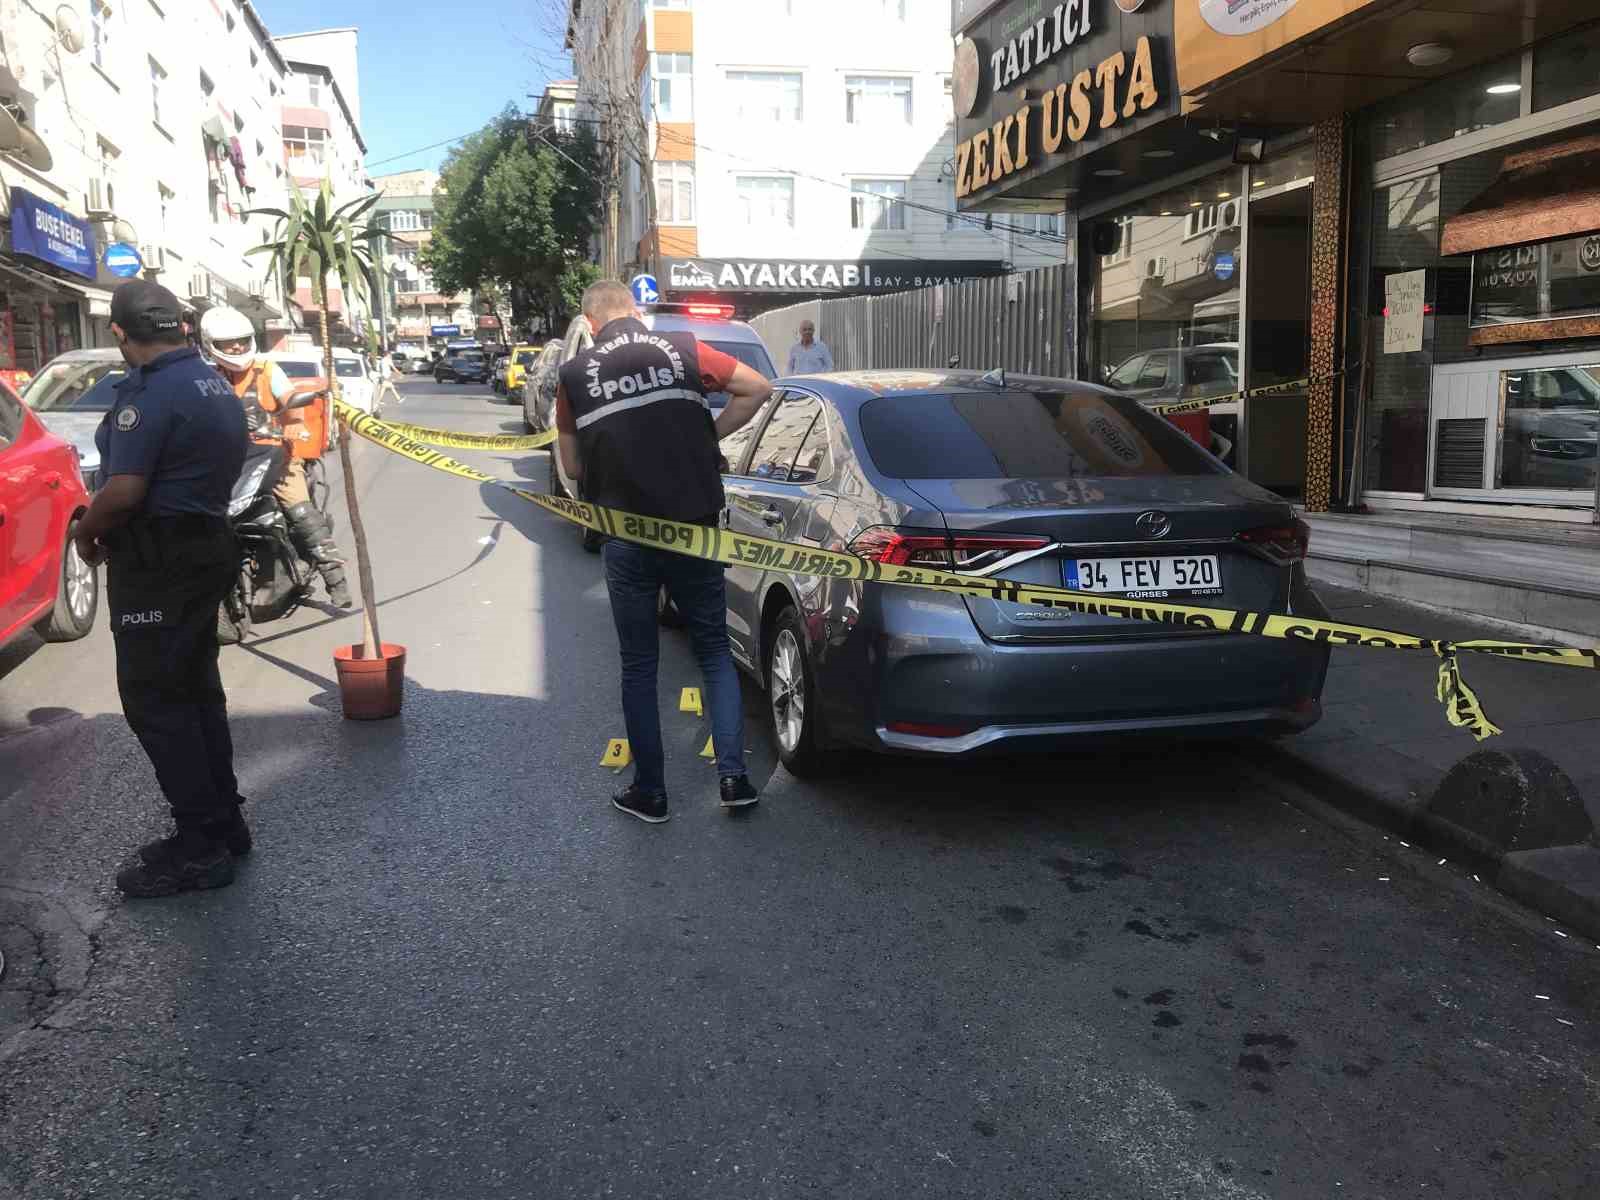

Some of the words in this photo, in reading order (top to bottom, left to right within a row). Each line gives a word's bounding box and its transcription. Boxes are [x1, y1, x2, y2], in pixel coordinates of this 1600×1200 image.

[990, 0, 1091, 92] TATLICI
[955, 87, 1030, 198] ZEKİ
[1040, 35, 1159, 155] USTA
[718, 264, 871, 289] AYAKKABI
[874, 276, 901, 287] BAY
[586, 358, 602, 398] OLAY
[1079, 562, 1108, 589] 34
[1120, 559, 1161, 588] FEV
[1173, 558, 1214, 585] 520
[613, 744, 622, 757] 3
